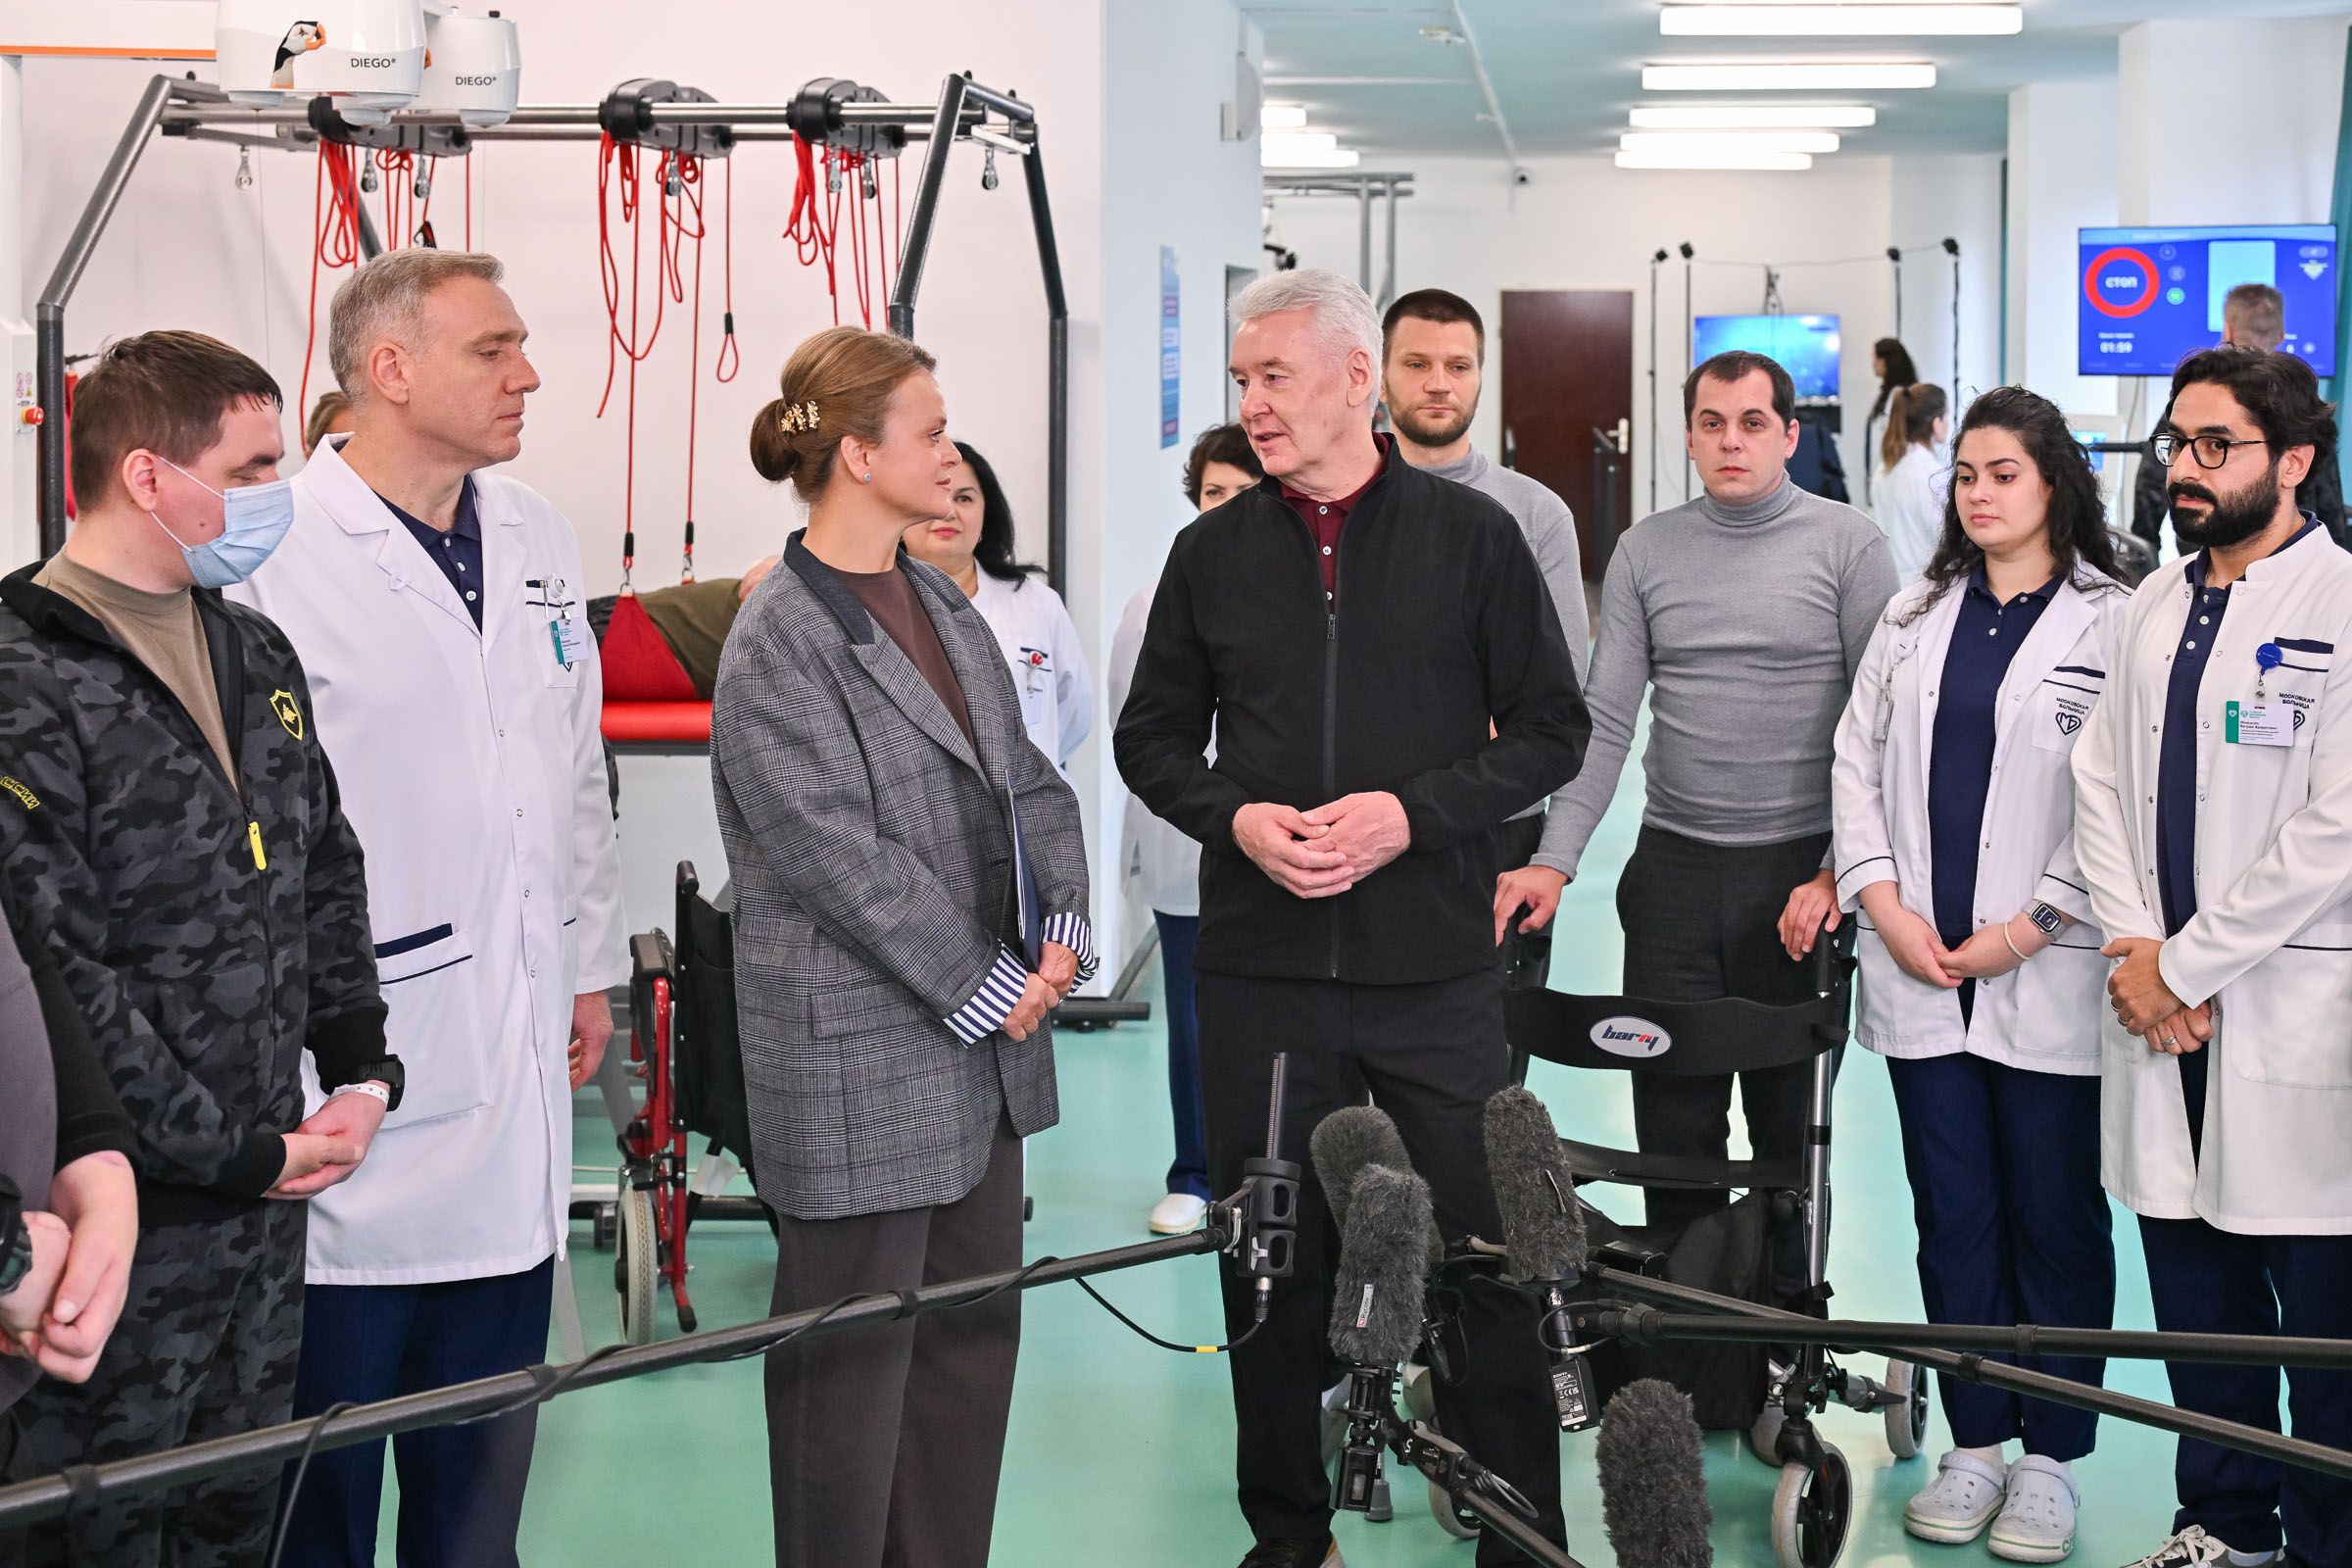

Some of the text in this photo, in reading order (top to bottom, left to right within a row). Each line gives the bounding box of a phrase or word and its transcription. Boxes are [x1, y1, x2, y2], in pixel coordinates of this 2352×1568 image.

[2056, 697, 2089, 710] МОСКОВСКАЯ
[2278, 692, 2316, 704] МОСКОВСКАЯ
[2059, 703, 2085, 715] БОЛЬНИЦА
[2281, 699, 2310, 710] БОЛЬНИЦА
[0, 775, 41, 809] ССИИ
